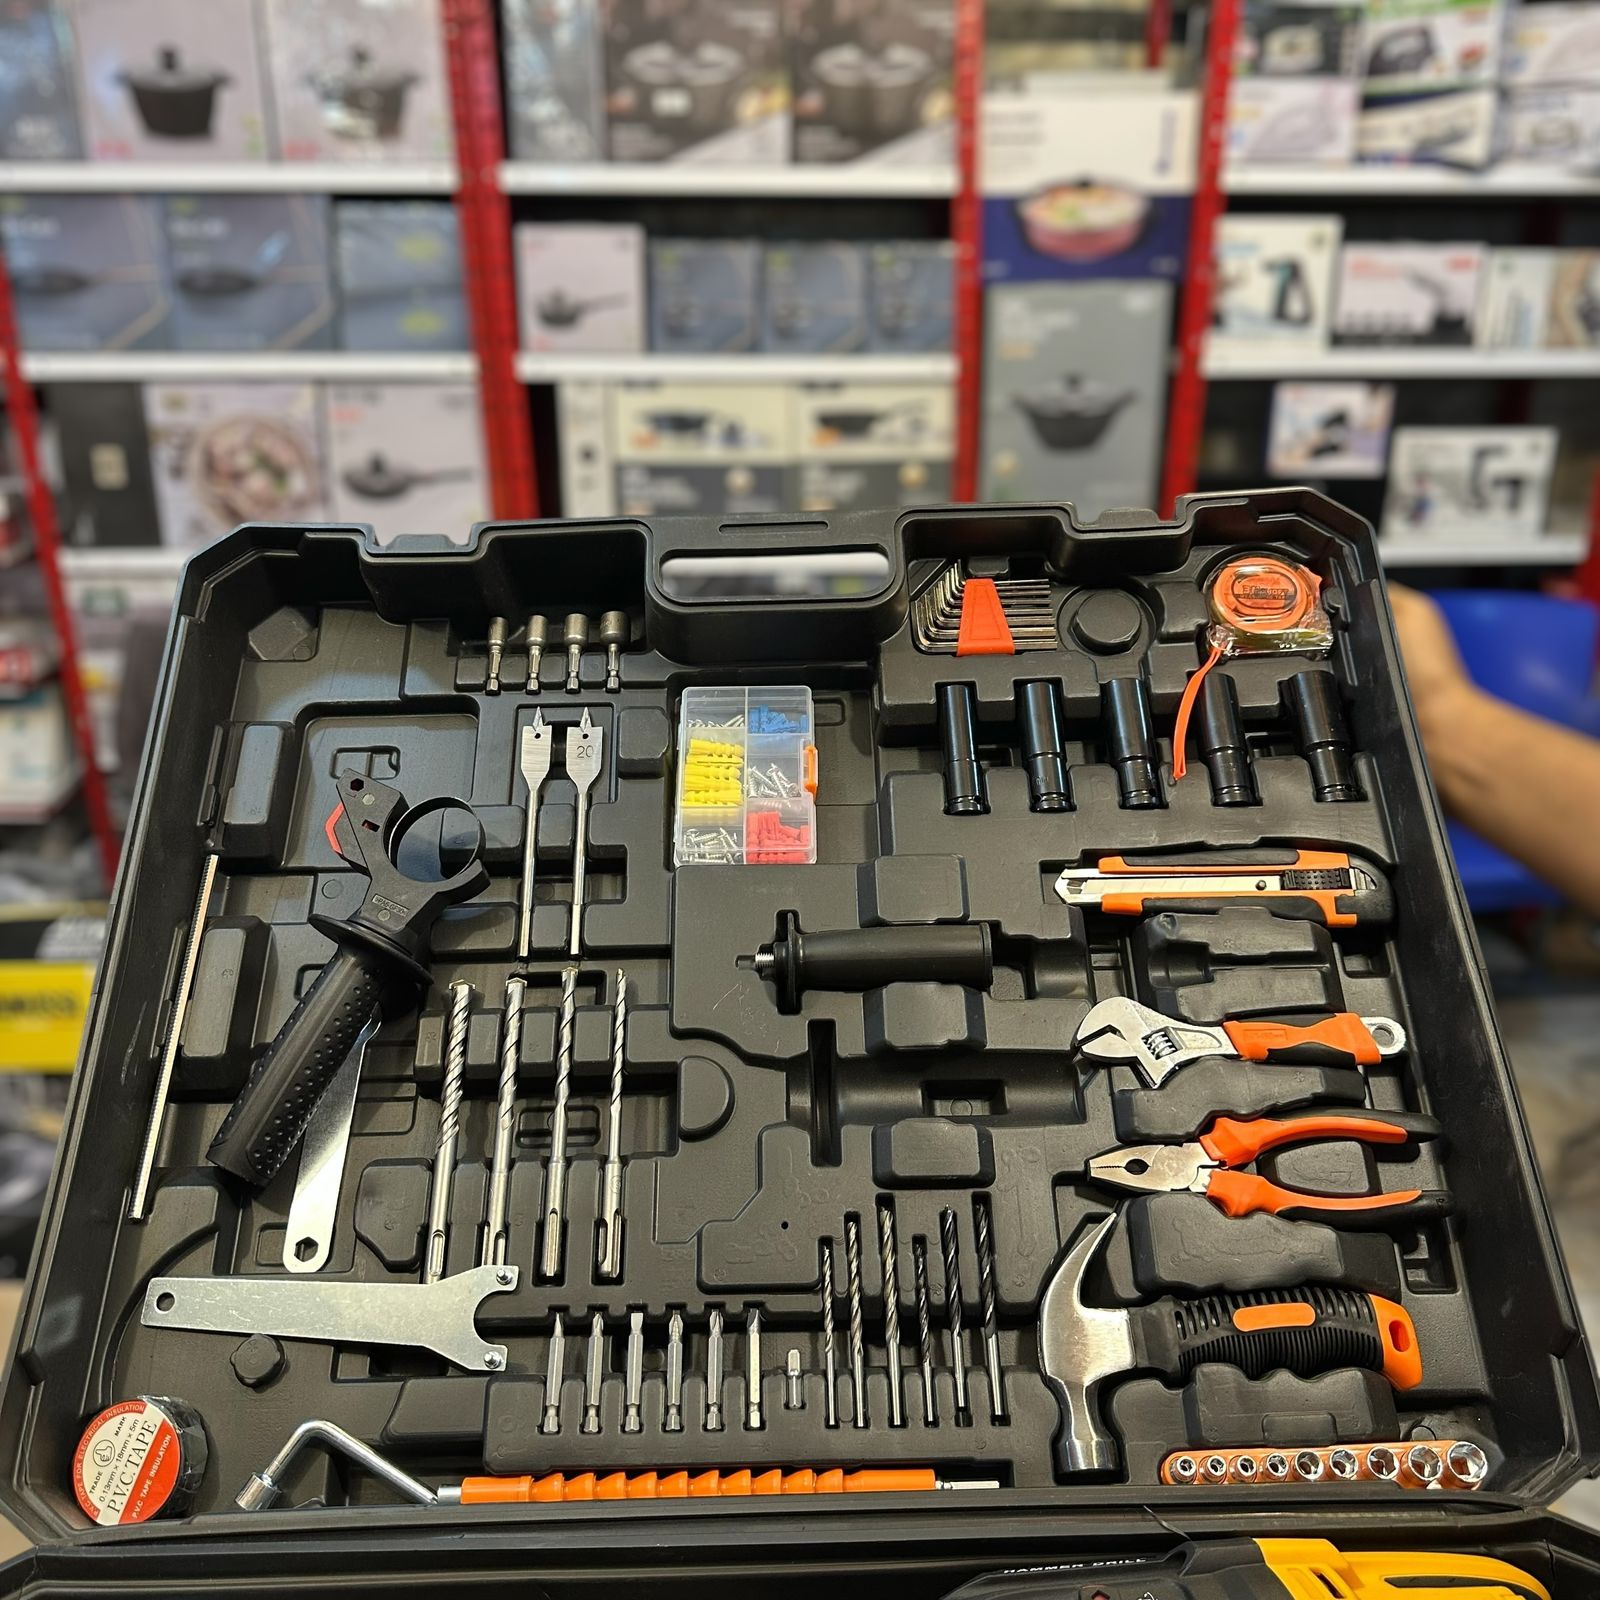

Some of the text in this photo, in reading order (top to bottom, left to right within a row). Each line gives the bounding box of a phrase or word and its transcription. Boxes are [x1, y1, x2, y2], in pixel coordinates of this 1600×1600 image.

[577, 745, 594, 759] 20
[105, 1404, 145, 1419] INSULATION
[78, 1418, 107, 1458] ELECTRICAL
[89, 1416, 127, 1494] TRADE MARK
[98, 1470, 117, 1503] 0.13mm
[115, 1439, 130, 1463] 18mm
[129, 1419, 140, 1432] 5m
[140, 1479, 153, 1498] TAPE
[149, 1434, 172, 1478] INSULATION
[77, 1482, 87, 1500] TAPE
